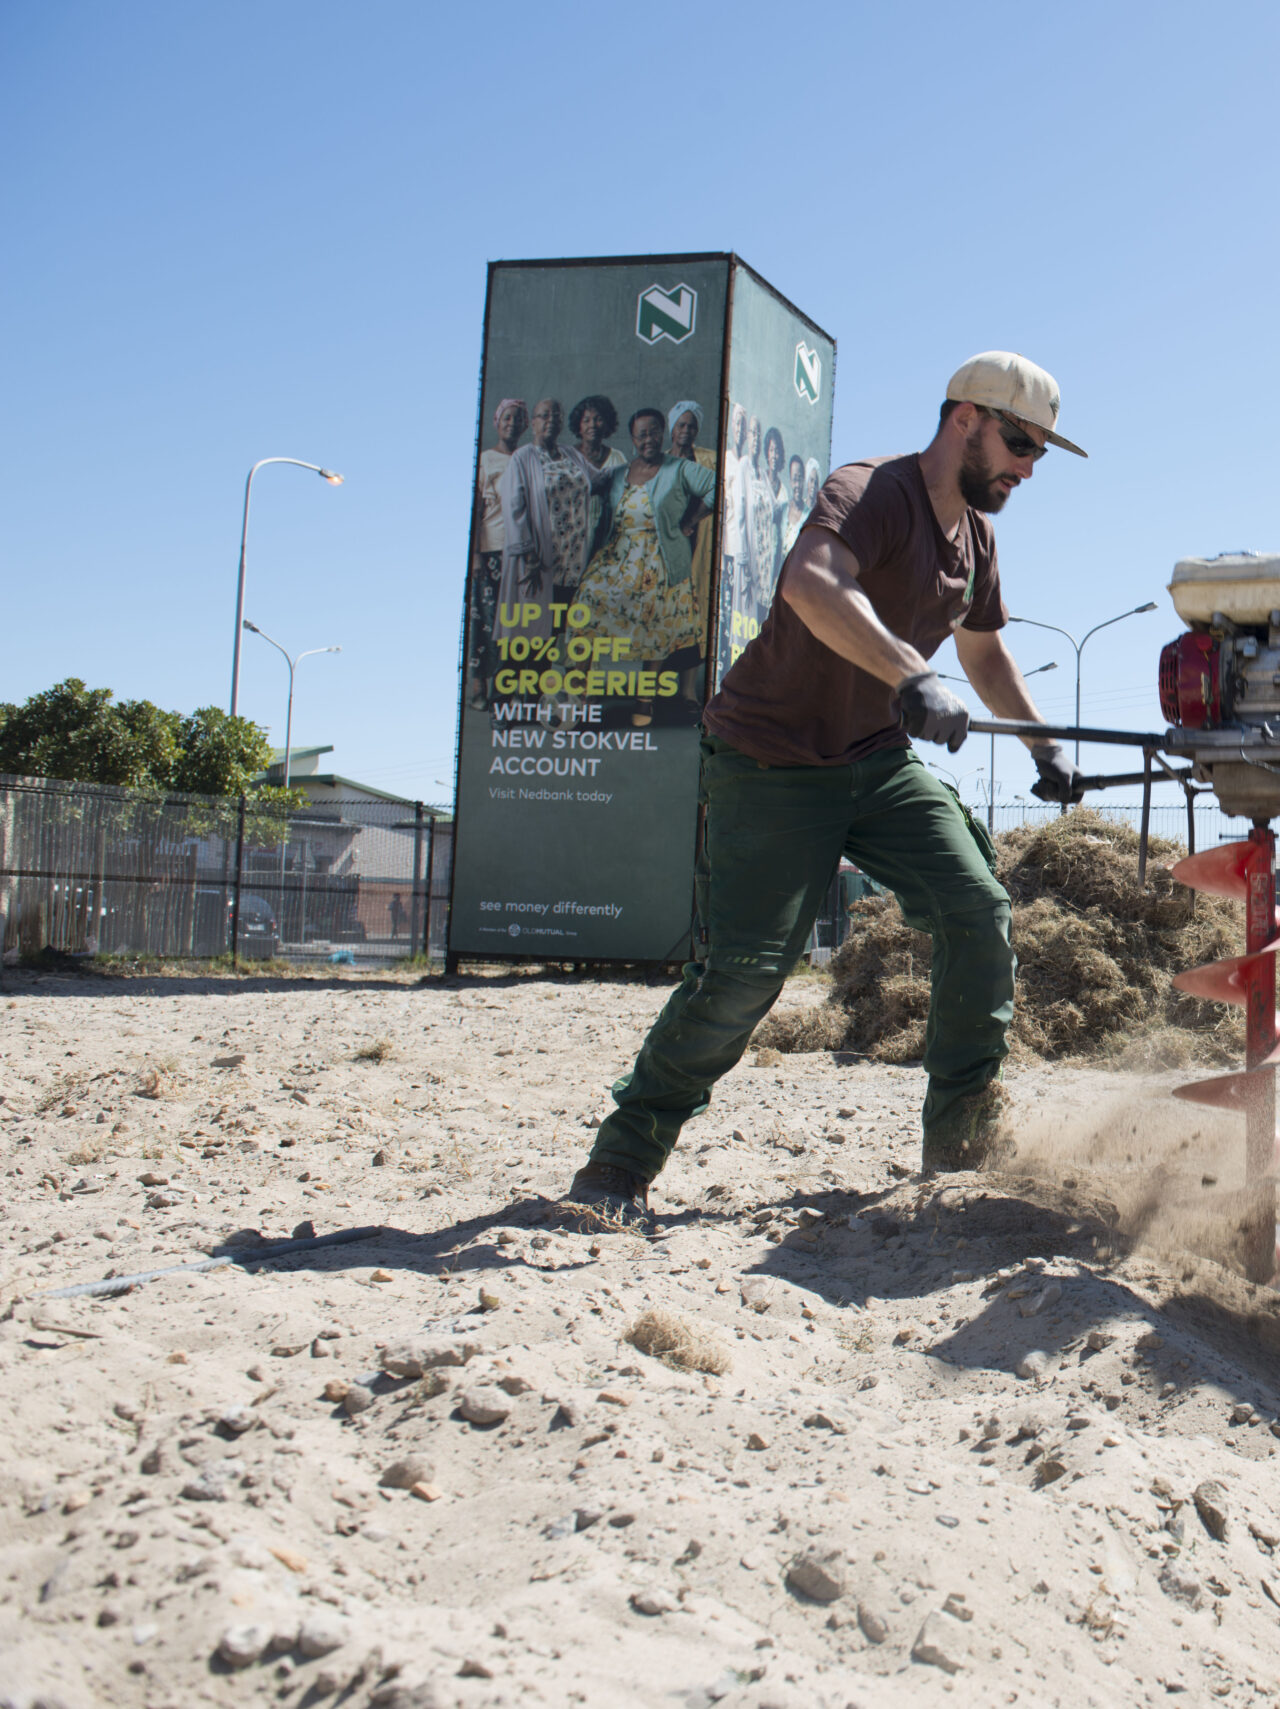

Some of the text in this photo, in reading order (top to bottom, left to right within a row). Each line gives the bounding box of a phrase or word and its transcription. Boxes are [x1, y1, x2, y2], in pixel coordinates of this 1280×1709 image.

[499, 603, 592, 629] UP TO
[732, 610, 762, 641] R10
[496, 635, 631, 662] 10% OFF
[494, 668, 680, 697] GROCERIES
[493, 702, 603, 723] WITH THE
[491, 729, 658, 751] NEW STOKVEL
[488, 756, 602, 777] ACCOUNT
[488, 787, 613, 805] Visit Nedbank today
[479, 901, 623, 919] see money differently
